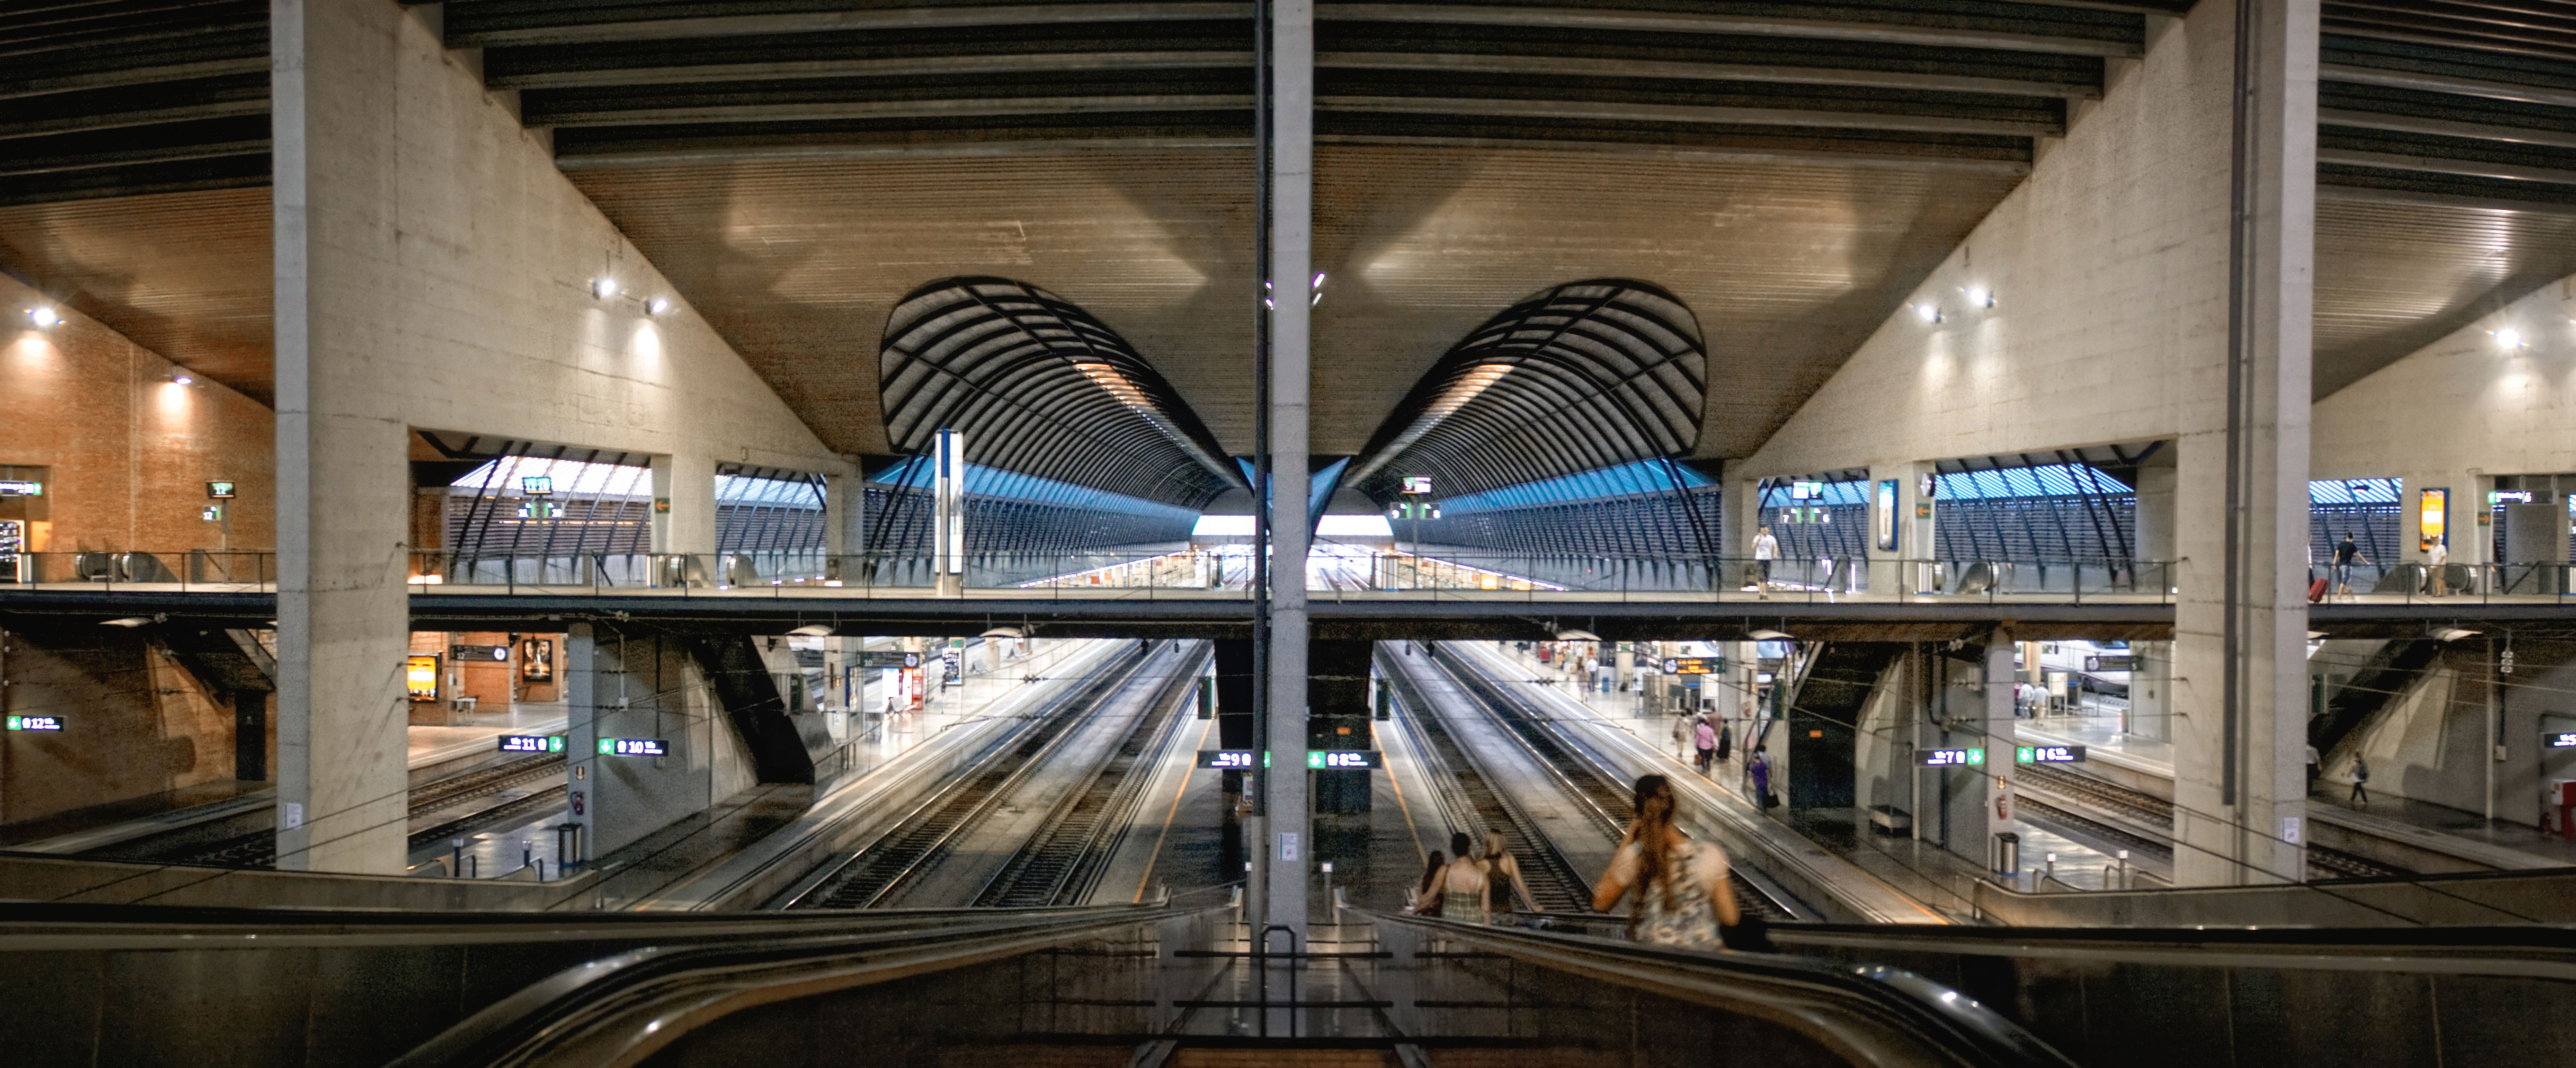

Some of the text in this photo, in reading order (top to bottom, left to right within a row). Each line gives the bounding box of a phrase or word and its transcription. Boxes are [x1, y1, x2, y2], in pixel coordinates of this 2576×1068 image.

[1783, 515, 1789, 523] 7
[1823, 514, 1830, 523] 6
[31, 718, 44, 729] 12
[522, 738, 536, 751] 11
[628, 740, 644, 754] 10
[1231, 753, 1240, 766] 9
[1339, 753, 1349, 766] 8
[1945, 751, 1954, 764] 7
[2046, 748, 2056, 760] 6
